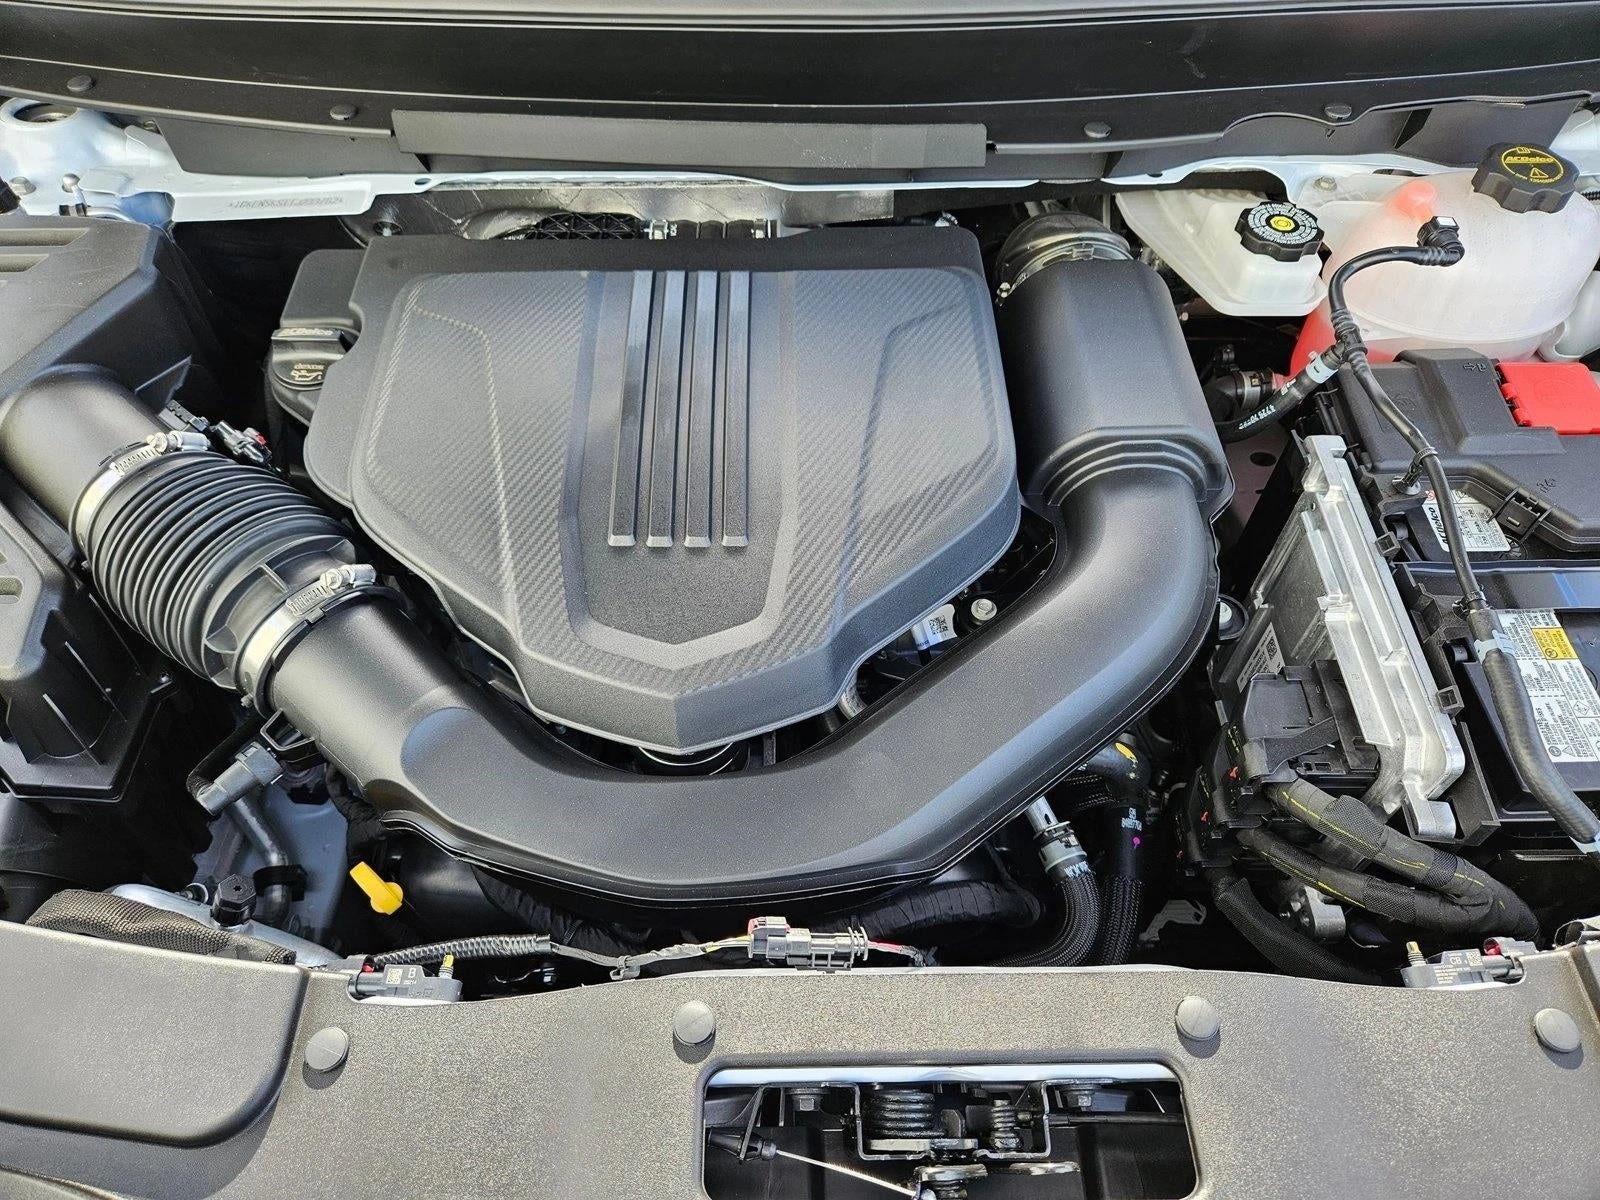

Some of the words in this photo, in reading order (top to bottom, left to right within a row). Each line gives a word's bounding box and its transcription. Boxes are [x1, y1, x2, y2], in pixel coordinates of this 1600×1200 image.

[1504, 156, 1554, 164] ACDelco
[1450, 956, 1462, 964] CB
[408, 967, 417, 978] B
